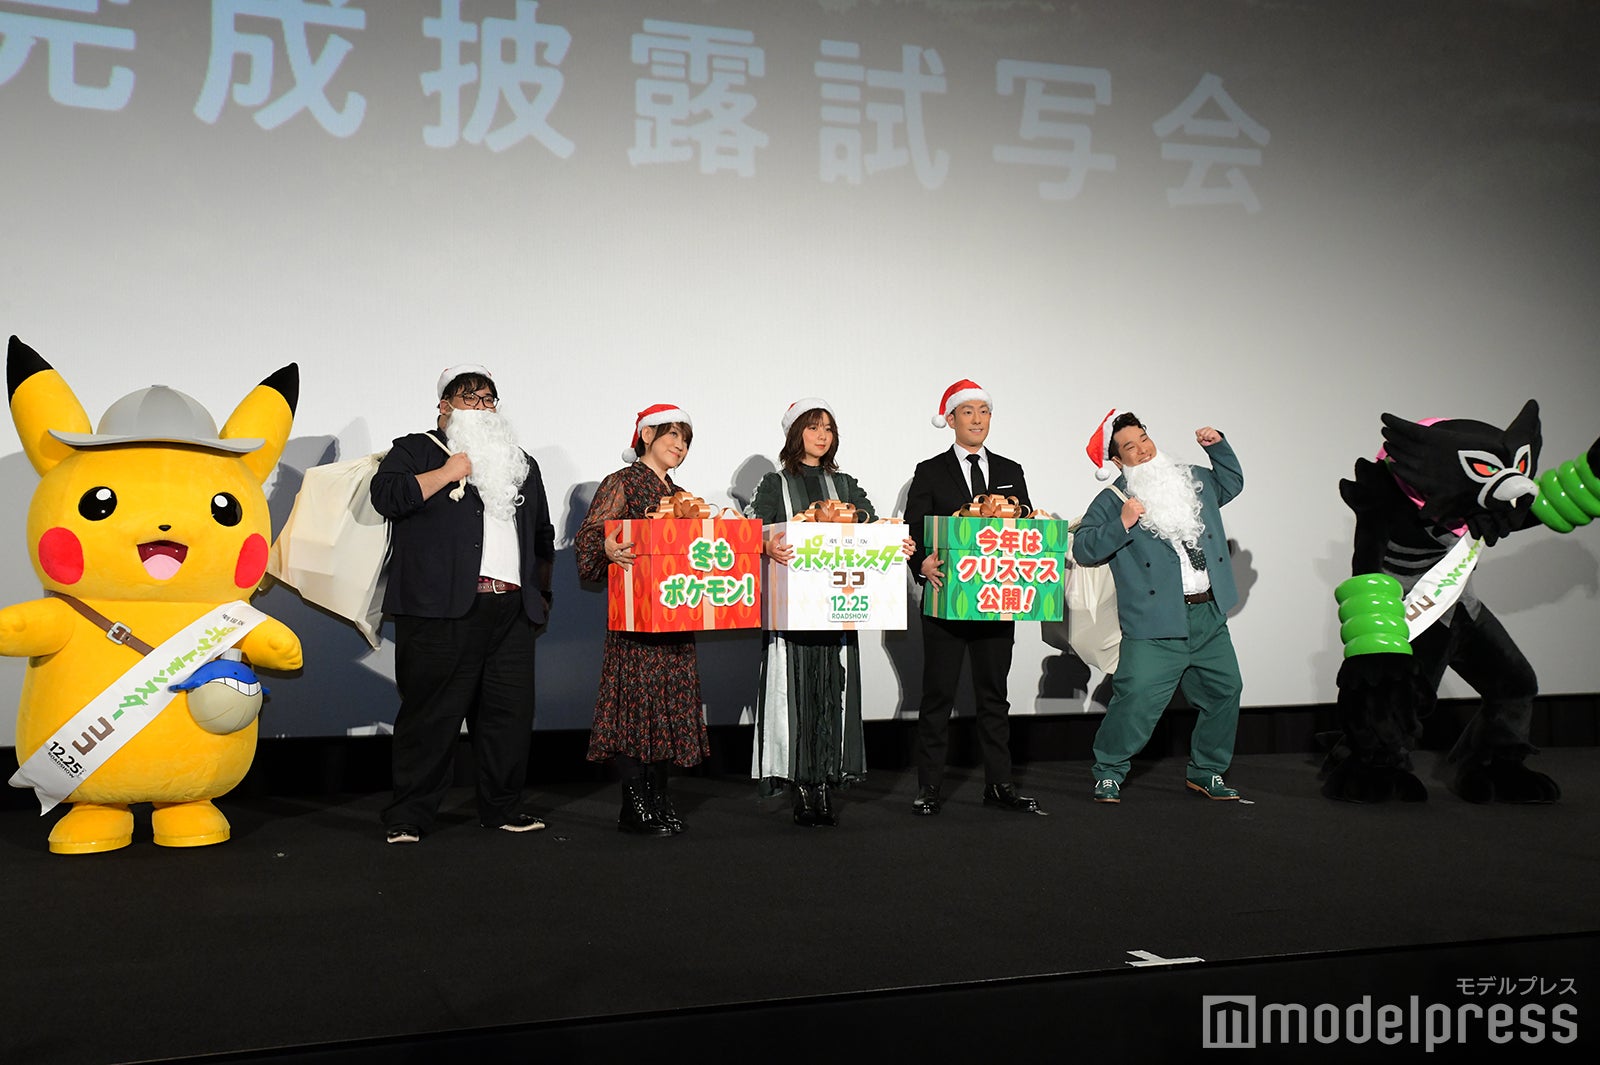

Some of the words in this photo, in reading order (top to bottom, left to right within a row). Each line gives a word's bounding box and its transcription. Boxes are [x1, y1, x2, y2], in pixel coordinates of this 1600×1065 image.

[793, 535, 904, 571] ポケットモンスター
[978, 528, 1041, 553] 今年は
[692, 541, 732, 568] 冬も
[833, 571, 865, 585] ココ
[959, 558, 1057, 580] クリスマス
[664, 576, 753, 605] ポケモン!
[831, 595, 868, 611] 12.25
[979, 587, 1034, 610] 公開!
[112, 626, 238, 721] ポケットモンスター
[71, 716, 115, 756] ココ
[49, 741, 83, 774] 12.25
